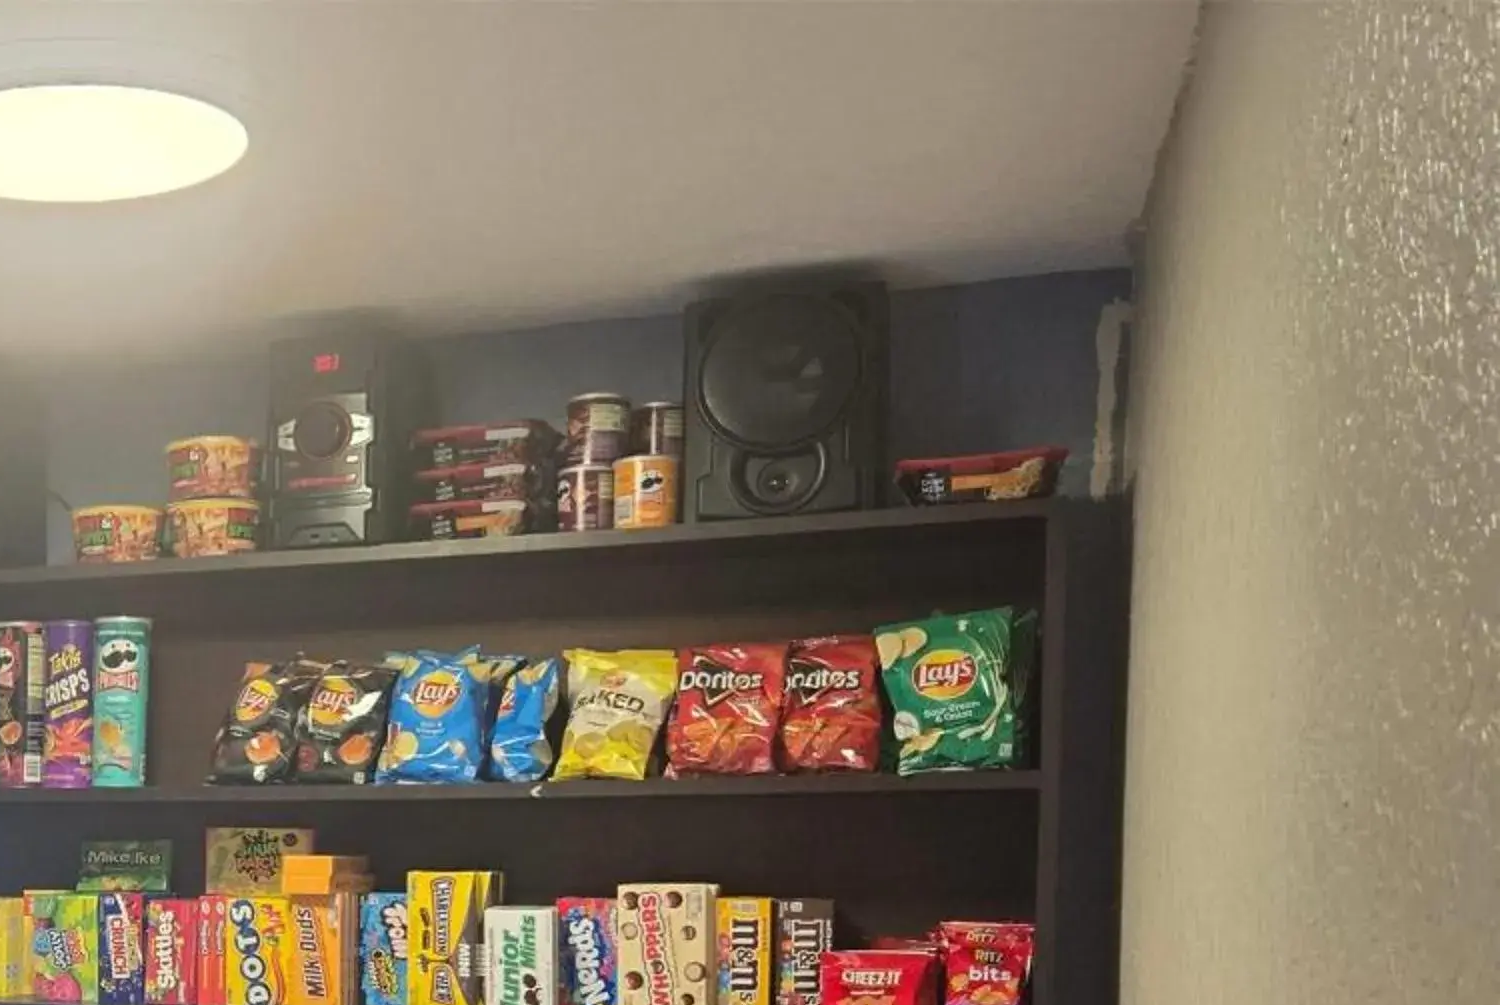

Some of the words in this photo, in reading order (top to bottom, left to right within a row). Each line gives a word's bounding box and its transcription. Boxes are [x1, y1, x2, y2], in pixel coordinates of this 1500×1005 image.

[45, 668, 91, 708] CRISPS
[680, 669, 764, 694] Doritos
[786, 668, 860, 694] oritos
[110, 917, 128, 977] CRUNCH
[156, 910, 177, 990] Skittles
[298, 907, 319, 950] Duds
[517, 914, 537, 969] Mints
[307, 950, 326, 998] Milk
[968, 965, 1012, 982] bits
